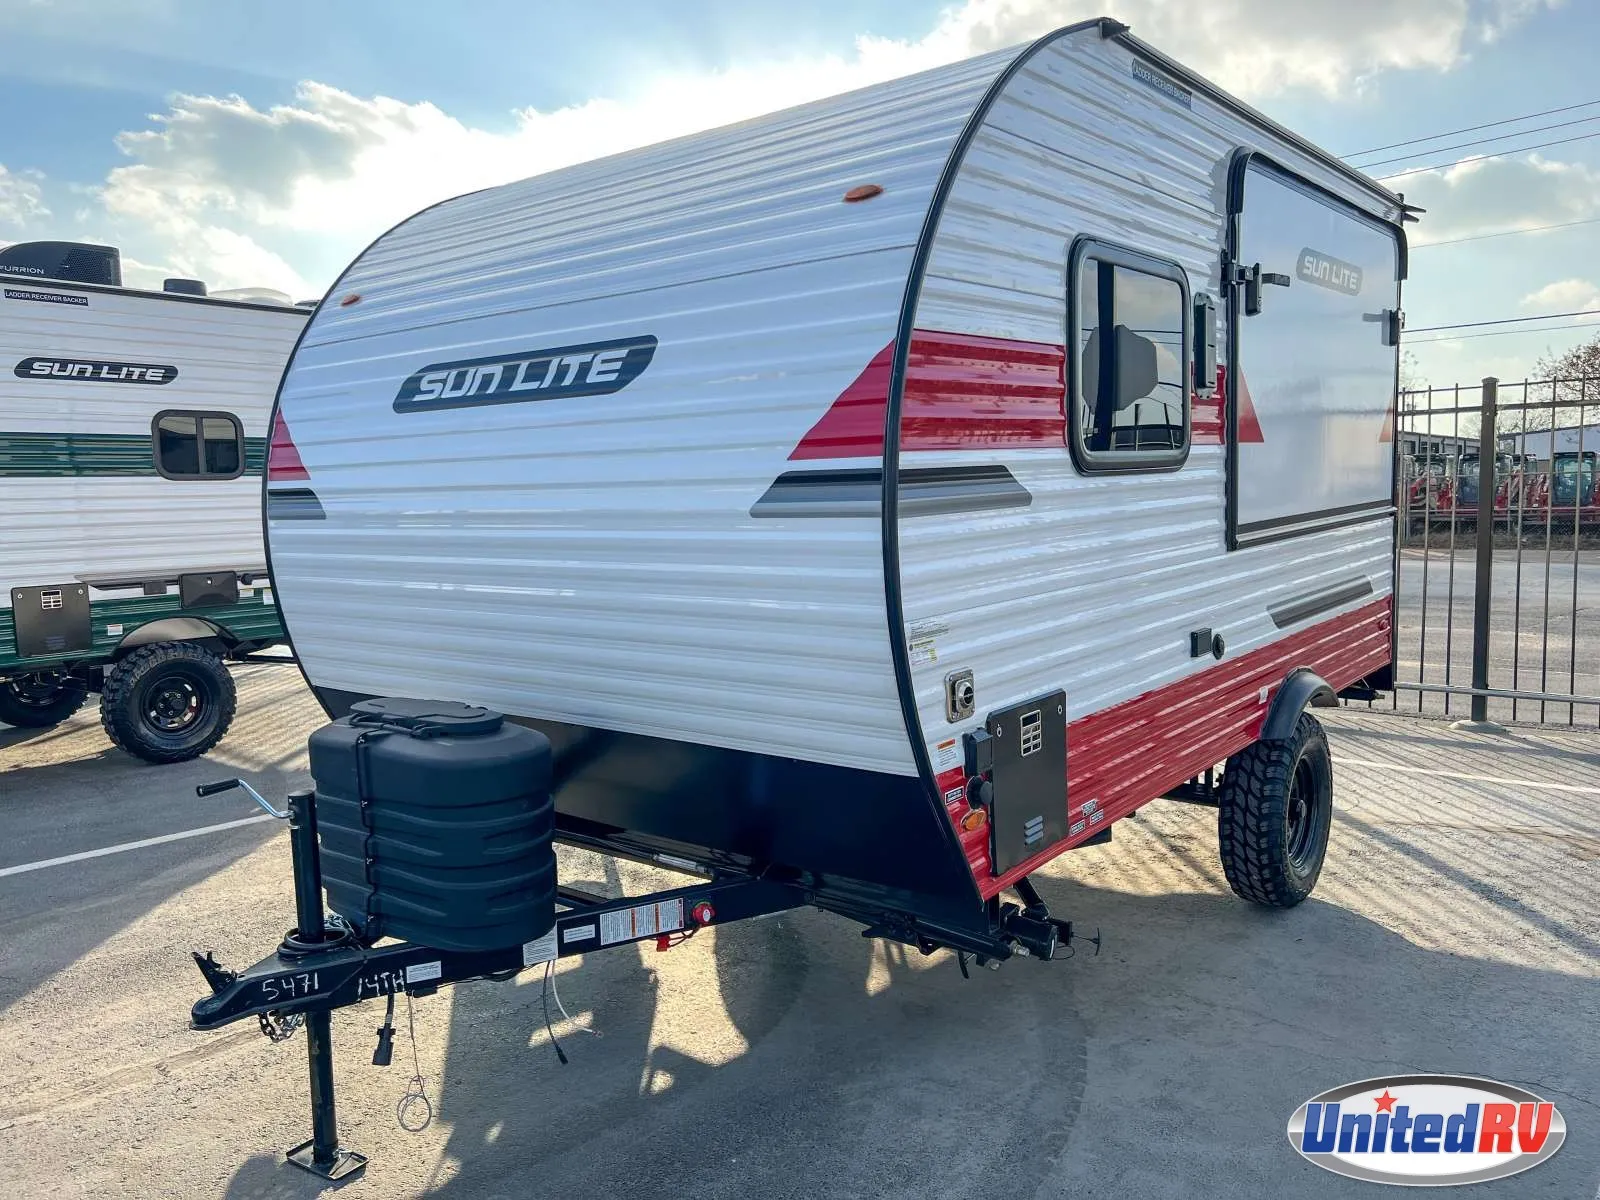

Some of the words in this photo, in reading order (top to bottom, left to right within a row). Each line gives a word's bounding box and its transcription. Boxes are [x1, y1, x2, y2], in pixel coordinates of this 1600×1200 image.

[1303, 255, 1330, 280] SUN
[1332, 265, 1358, 290] LITE
[5, 291, 31, 299] LADDER
[32, 293, 62, 301] RECEIVER
[30, 361, 93, 377] SUN
[100, 366, 165, 381] LITE
[412, 365, 504, 401] SUN
[509, 349, 630, 391] LITE
[262, 972, 319, 1001] 5471
